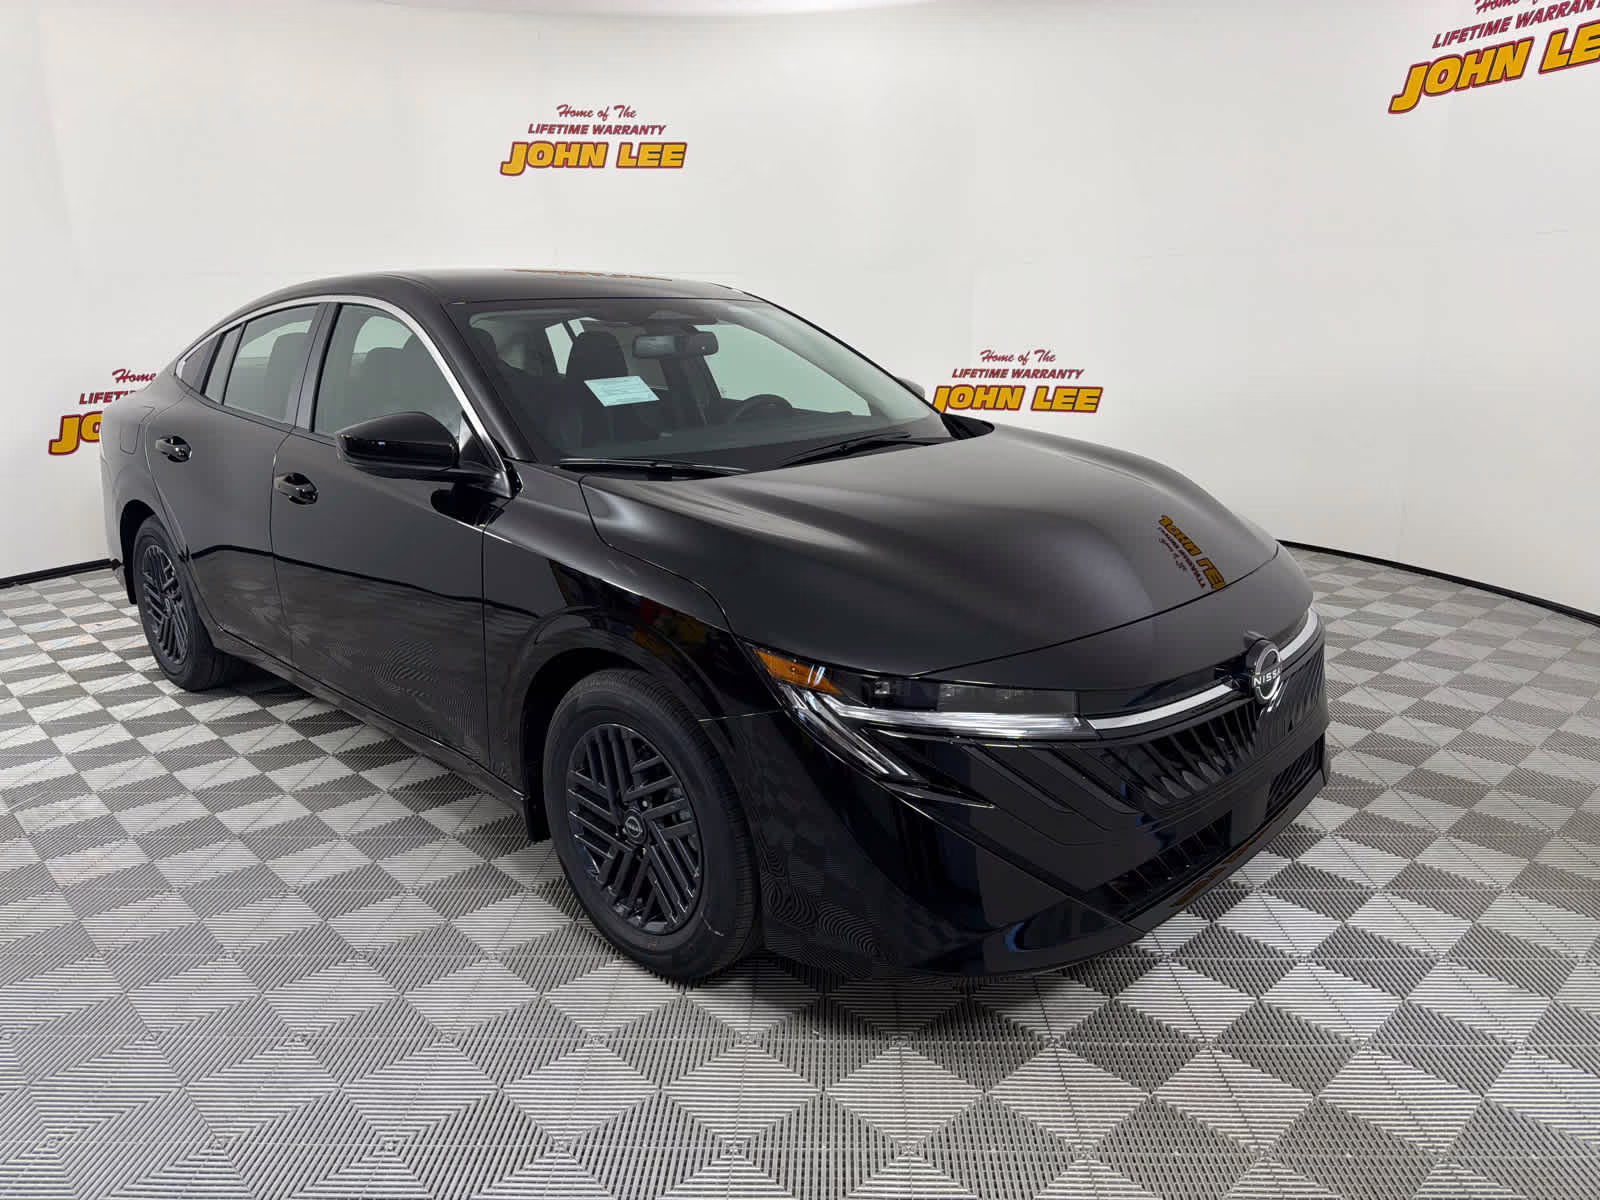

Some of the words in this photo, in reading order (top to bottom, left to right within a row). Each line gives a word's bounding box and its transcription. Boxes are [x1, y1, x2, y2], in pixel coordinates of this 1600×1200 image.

[1432, 16, 1513, 48] LIFETIME
[1515, 0, 1600, 29] WARRAN
[1388, 36, 1535, 114] JOHN
[1538, 20, 1600, 74] LE
[556, 104, 593, 118] Home
[597, 106, 610, 121] of
[613, 104, 637, 118] The
[528, 123, 589, 135] LIFETIME
[592, 124, 666, 136] WARRANTY
[500, 140, 609, 176] JOHN
[616, 142, 687, 168] LEE
[980, 349, 1014, 363] Home
[1017, 351, 1030, 366] of
[1034, 349, 1056, 363] The
[112, 368, 156, 384] Home
[952, 368, 1009, 379] LIFETIME
[1011, 369, 1084, 380] WARRANTY
[79, 390, 136, 405] LIFET
[933, 384, 1026, 413] JOHN
[1031, 386, 1103, 413] LEE
[48, 411, 103, 456] JO
